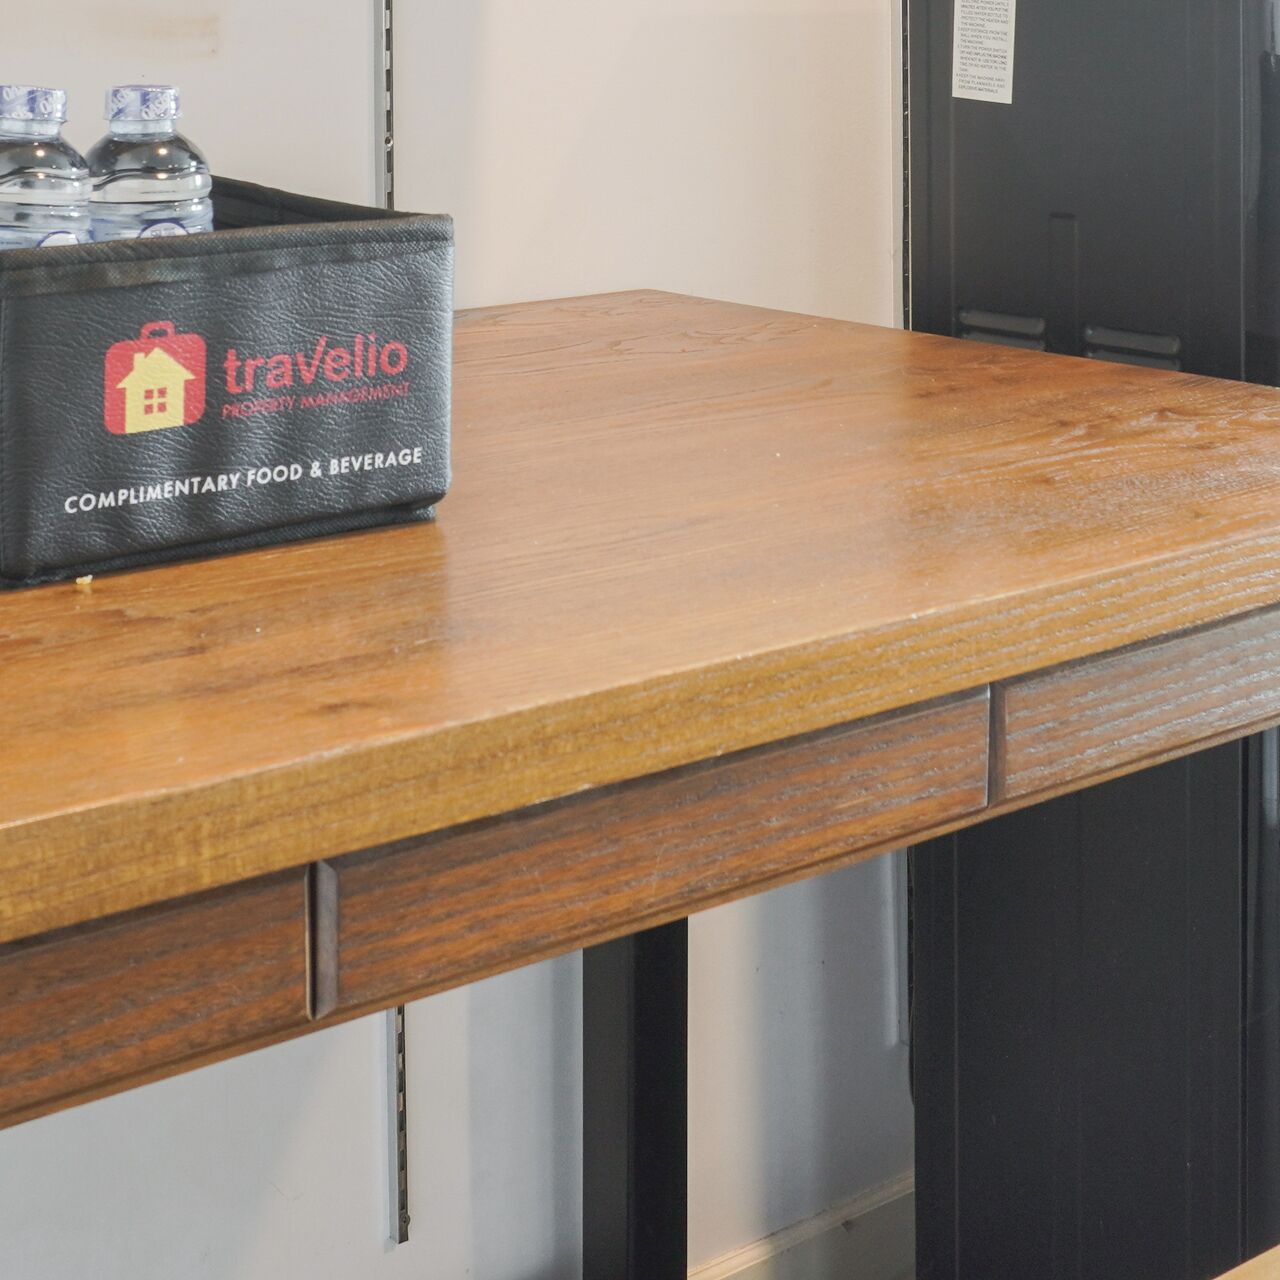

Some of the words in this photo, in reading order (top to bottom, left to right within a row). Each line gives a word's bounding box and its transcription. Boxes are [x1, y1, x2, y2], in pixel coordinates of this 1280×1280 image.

[224, 331, 408, 394] travelio
[64, 472, 241, 514] COMPLIMENTARY
[246, 464, 303, 487] FOOD
[310, 461, 322, 478] &
[329, 447, 423, 475] BEVERAGE
